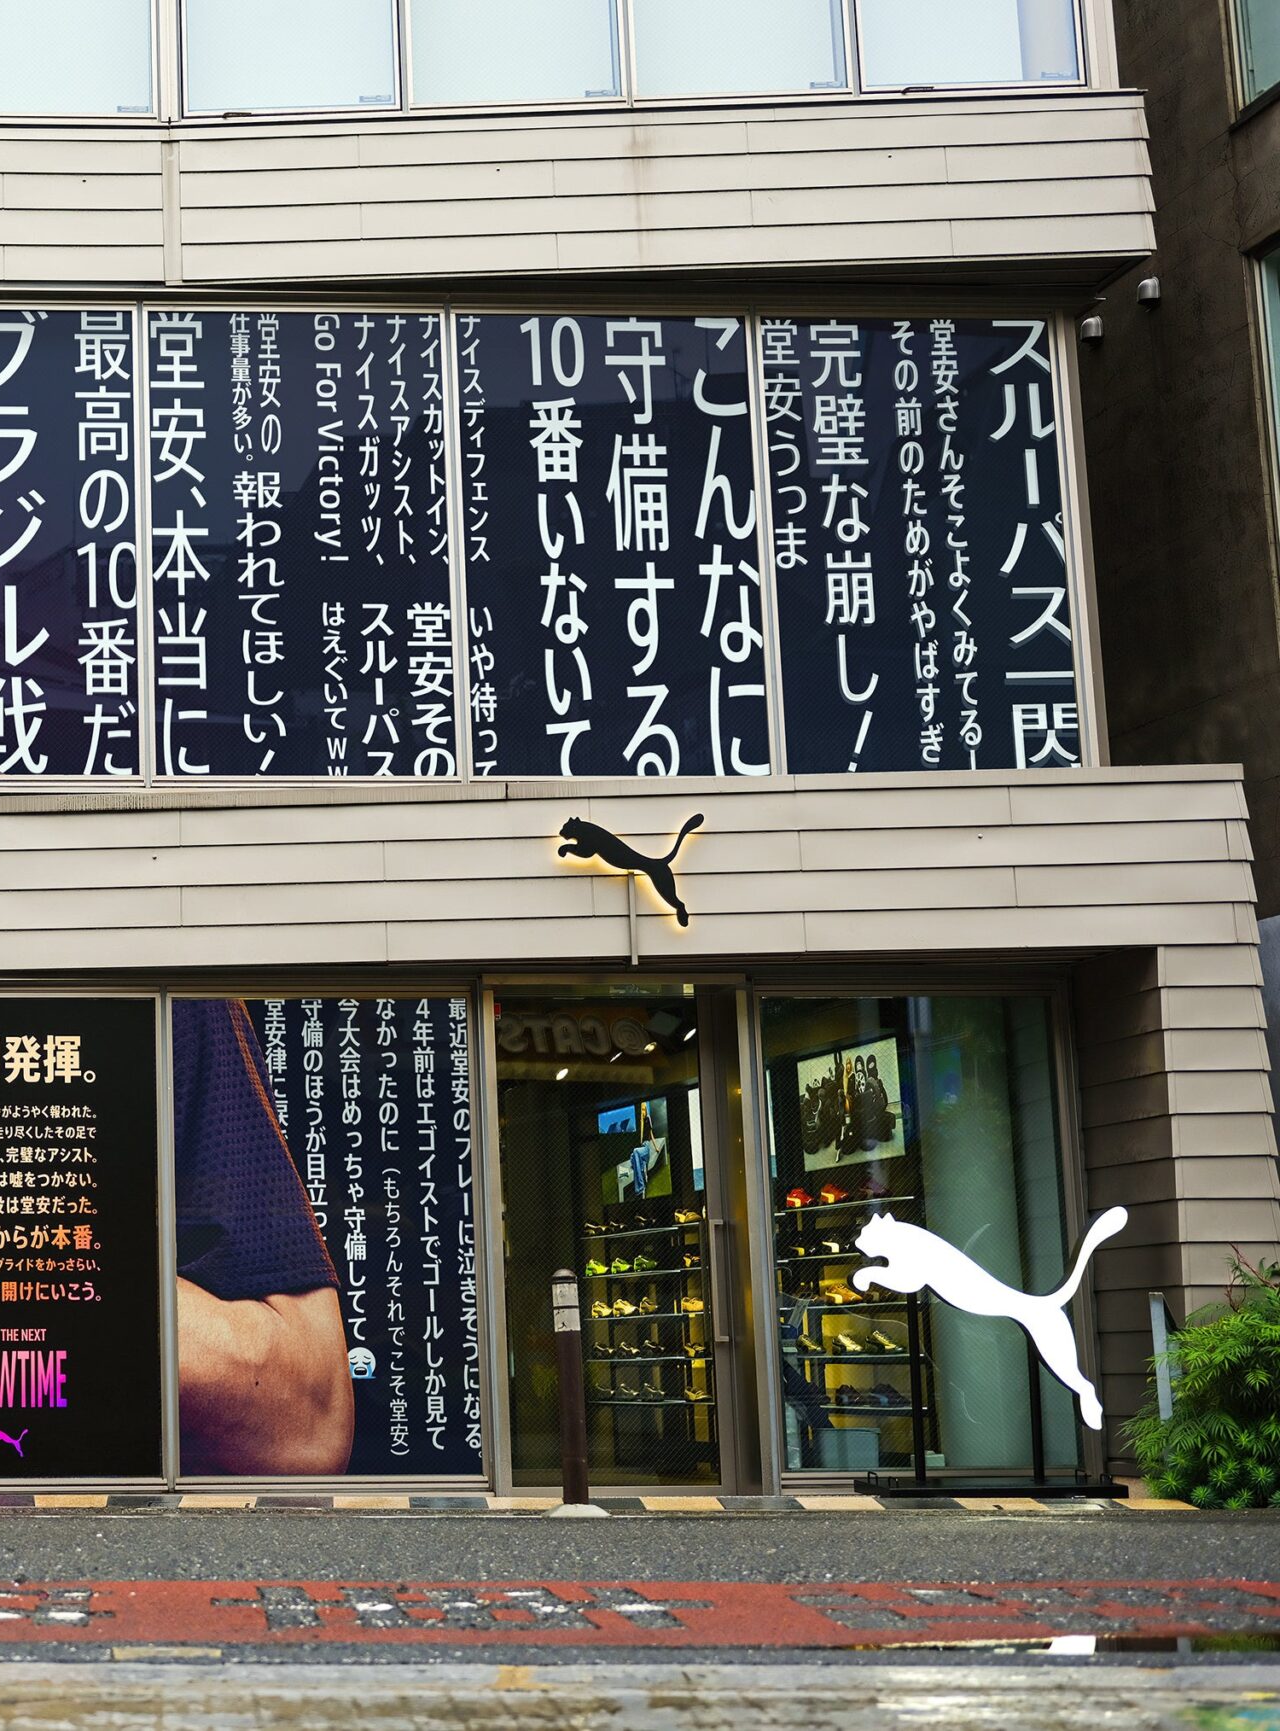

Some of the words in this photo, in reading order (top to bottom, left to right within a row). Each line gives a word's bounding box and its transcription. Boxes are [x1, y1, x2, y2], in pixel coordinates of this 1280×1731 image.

[229, 313, 254, 462] 仕事量が多い。
[257, 313, 282, 455] 堂安の
[314, 314, 340, 351] Go
[315, 362, 342, 413] For
[353, 314, 384, 566] ナイスガッツ、
[385, 314, 418, 565] ナイスアシスト、
[418, 312, 450, 565] ナイスカットイン、
[459, 315, 491, 564] ナイスディフェンス
[72, 307, 139, 778] 最高の10番だ
[148, 312, 213, 779] 堂安、本当に
[313, 419, 349, 561] Victory!
[519, 316, 593, 777] 10番いないて
[604, 317, 680, 777] 守備する
[693, 317, 771, 776] こんなに
[809, 319, 881, 774] 完璧な崩し！
[891, 319, 946, 763] その前のためがやばすぎ
[231, 470, 288, 780] 報われてほしい！
[357, 603, 403, 778] スルーパス
[405, 601, 456, 778] 堂安その
[469, 606, 498, 777] いや待って
[300, 999, 328, 1241] 守備のほうが目立っ
[337, 998, 367, 1341] 今大会はめっちゃ守備してて
[412, 998, 448, 1450] 4年前はエゴイストでゴールしか見て
[0, 1328, 19, 1342] THE
[20, 1328, 47, 1342] NEXT
